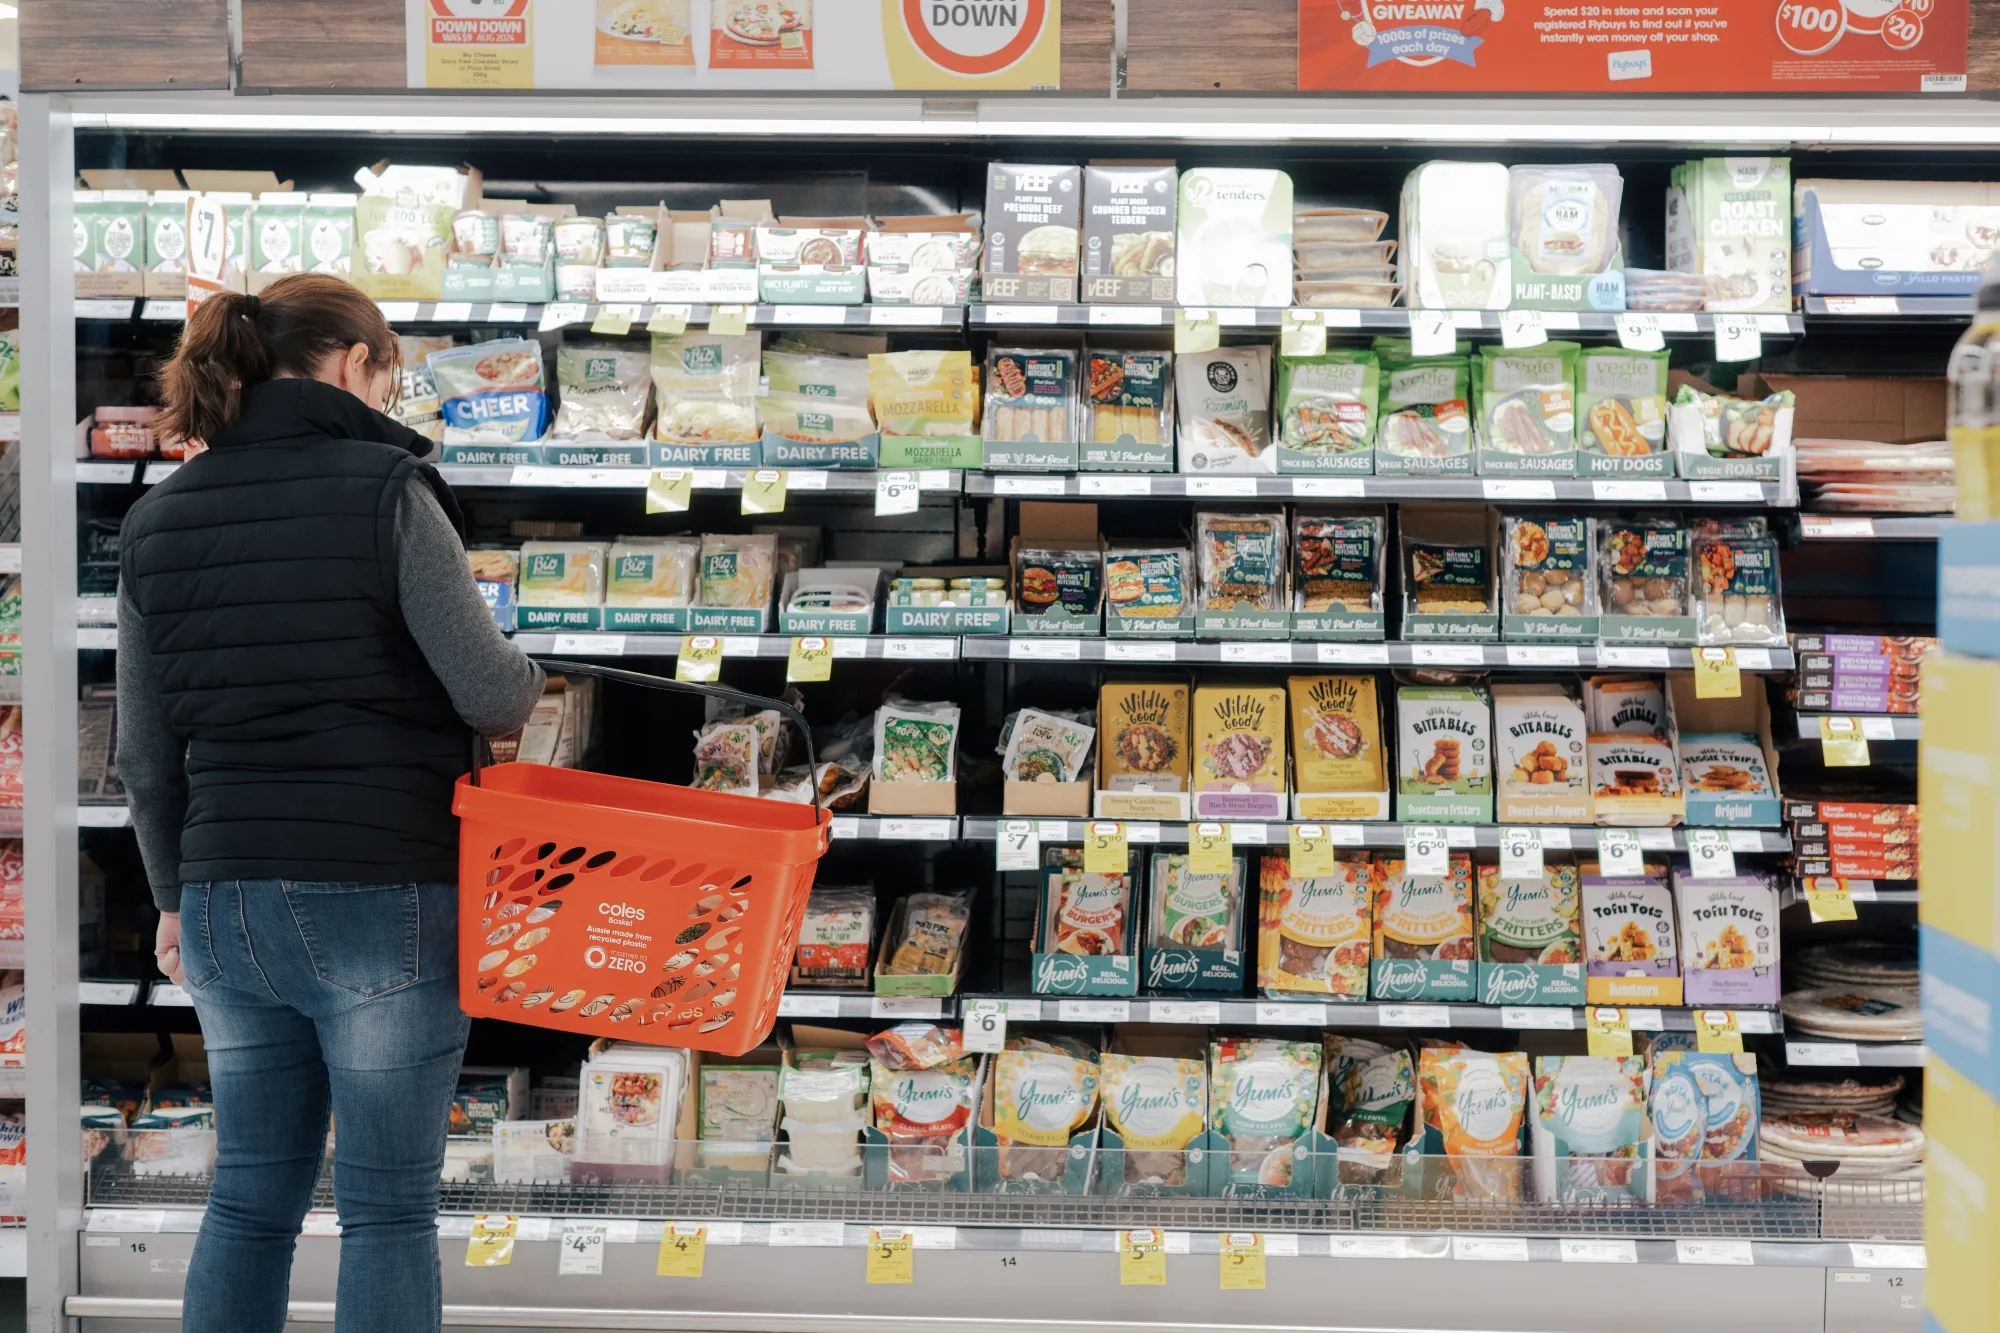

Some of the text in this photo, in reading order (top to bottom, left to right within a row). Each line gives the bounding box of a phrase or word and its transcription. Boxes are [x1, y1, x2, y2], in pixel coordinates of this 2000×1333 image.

[932, 4, 1017, 26] DOWN
[1372, 4, 1465, 20] GIVEAWAY
[1543, 6, 1718, 18] Spend $20 in store and scan your
[1782, 4, 1838, 33] $100
[435, 20, 522, 33] DOWN DOWN
[1534, 19, 1728, 31] registered Flybuys to find out if you've
[1888, 14, 1917, 41] $20
[1378, 28, 1466, 45] 1000s of prizes
[1540, 33, 1719, 45] instantly won money off your shop.
[1392, 41, 1451, 55] each day
[1217, 189, 1266, 201] tenders
[1003, 202, 1063, 213] PREMIUM BEEF
[1719, 200, 1777, 219] ROAST
[1710, 219, 1784, 238] CHICKEN
[455, 392, 531, 421] CHEER
[882, 399, 960, 417] MOZZARELLA
[455, 451, 529, 466] DAIRY FREE
[559, 452, 632, 467] DAIRY FREE
[660, 446, 751, 464] DAIRY FREE
[776, 446, 869, 462] DAIRY FREE
[904, 447, 962, 458] MOZZARELLA
[1025, 452, 1069, 467] Plant Based
[1122, 450, 1166, 464] Plant Based
[1281, 456, 1370, 470] THICK BBQ SAUSAGES
[1380, 457, 1468, 471] VEGIE SAUSAGES
[1484, 458, 1574, 472] THICK BBQ SAUSAGES
[1591, 458, 1663, 472] HOT DOGS
[528, 611, 589, 624] DAIRY FREE
[614, 611, 675, 626] DAIRY FREE
[694, 613, 755, 628] DAIRY FREE
[787, 618, 857, 632] DAIRY FREE
[901, 611, 990, 627] DAIRY FREE
[1239, 618, 1284, 630] Plant Based
[1332, 618, 1378, 631] Plant Based
[1039, 619, 1085, 632] Plant Based
[1133, 619, 1180, 632] Plant Based
[1448, 622, 1494, 635] Plant Based
[1535, 621, 1583, 634] Plant Based
[1632, 626, 1680, 639] Plant Based
[1308, 679, 1359, 704] Wildly
[1119, 689, 1170, 716] Wildly
[1213, 694, 1266, 721] Wildly
[1412, 718, 1478, 737] BITEABLES
[1509, 722, 1574, 740] BITEABLES
[1597, 757, 1662, 768] BITEABLES
[1110, 798, 1173, 808] Smoky Cauliflower
[1129, 806, 1155, 815] Burgers
[1407, 803, 1481, 817] Sweetcorn Fritters
[1714, 803, 1753, 822] Original
[1007, 833, 1029, 850] $7
[1076, 884, 1109, 906] Yumi's
[1299, 879, 1345, 908] Yumi's
[1400, 878, 1444, 908] Yumi's
[1505, 884, 1550, 913] Yumi's
[598, 901, 645, 921] coles
[1592, 902, 1664, 919] Tofu Tots
[1692, 904, 1765, 923] Tofu Tots
[608, 917, 633, 927] Basket
[1065, 911, 1117, 926] BURGERS
[1284, 914, 1357, 936] FRITTERS
[1386, 914, 1459, 936] FRITTERS
[586, 925, 652, 942] Aussie made from
[1493, 917, 1564, 938] FRITTERS
[589, 934, 647, 949] recycled plastic
[610, 950, 638, 959] TOGETHER
[608, 957, 646, 974] ZERO
[1148, 950, 1201, 988] Yumi's
[1211, 965, 1231, 974] REAL.
[1036, 957, 1089, 993] Yumi's
[1091, 977, 1129, 987] DELICIOUS.
[1100, 971, 1120, 979] REAL.
[1202, 971, 1239, 981] DELICIOUS.
[1374, 962, 1429, 1000] Yumi's
[1439, 973, 1460, 982] REAL.
[1430, 980, 1469, 990] DELICIOUS.
[1485, 968, 1540, 1005] Yumi's
[1541, 985, 1580, 995] DELICIOUS.
[1550, 980, 1570, 988] REAL.
[974, 1012, 997, 1031] $6
[896, 1078, 954, 1118] Yumi's
[1017, 1080, 1077, 1121] Yumi's
[1235, 1075, 1295, 1112] Yumi's
[1118, 1082, 1182, 1125] Yumi's
[1562, 1084, 1620, 1127] Yumi's
[130, 1242, 147, 1254] 16
[1000, 1257, 1017, 1268] 14
[1887, 1277, 1904, 1289] 12
